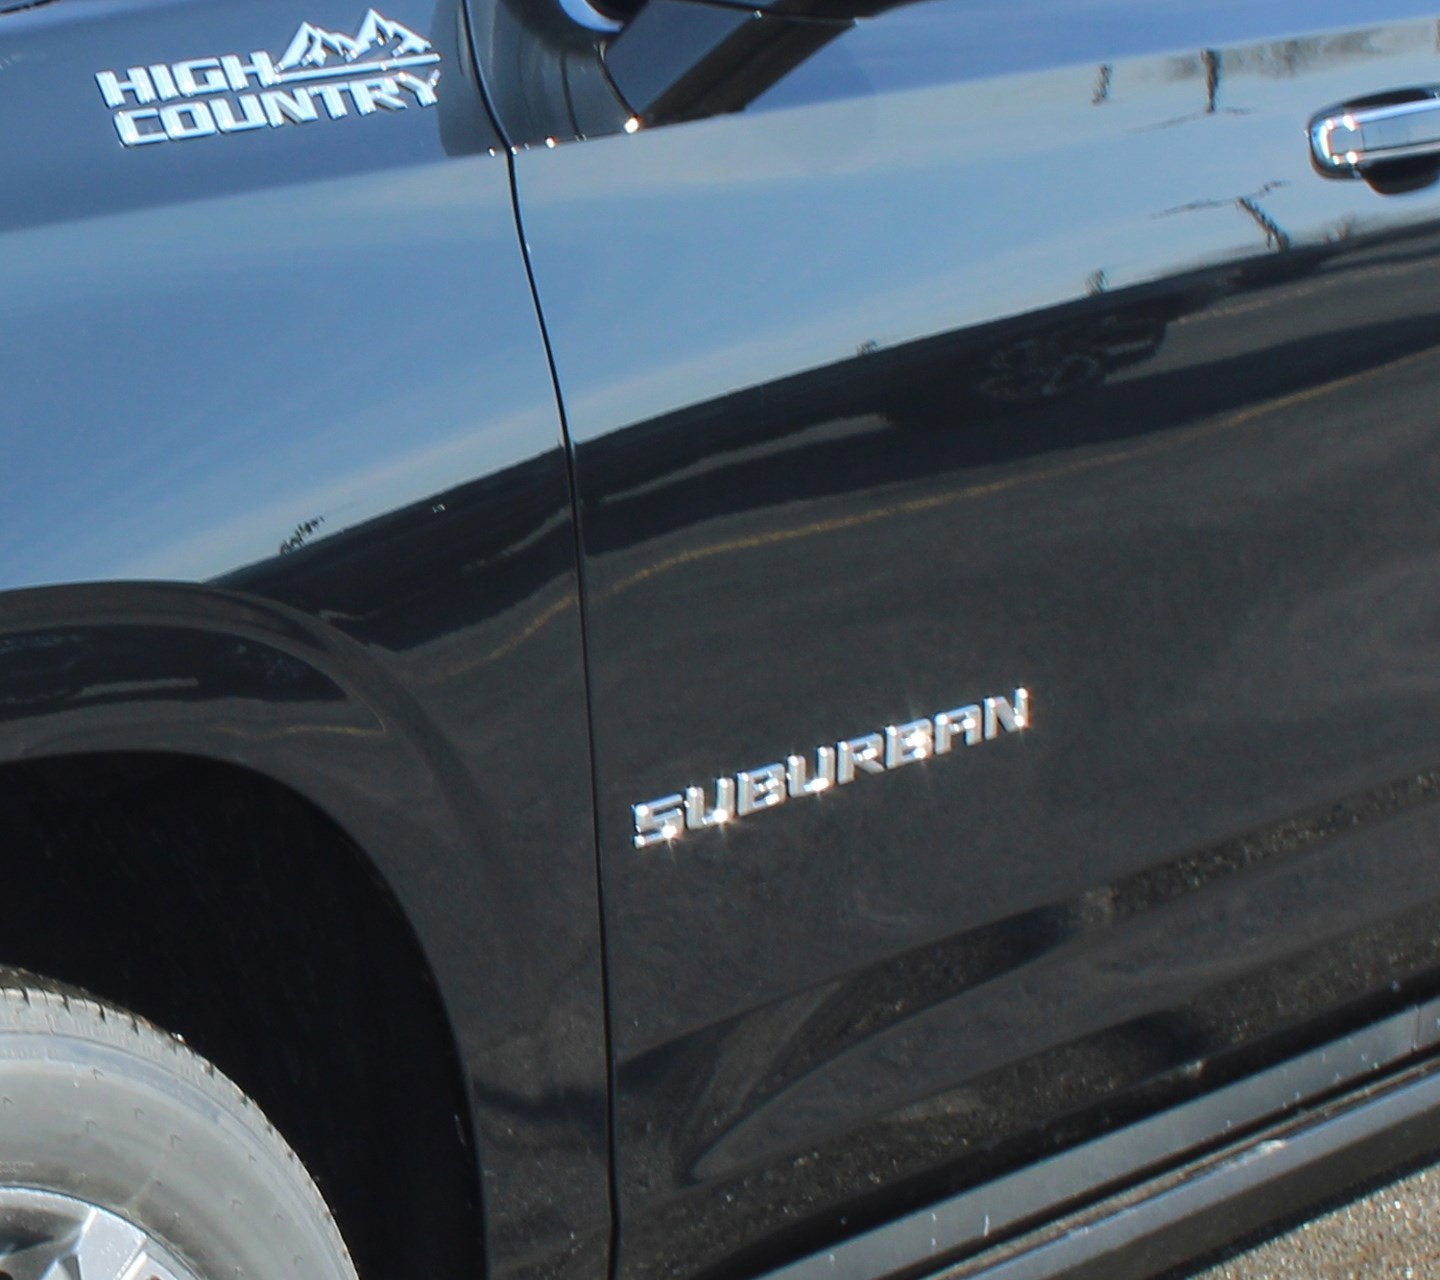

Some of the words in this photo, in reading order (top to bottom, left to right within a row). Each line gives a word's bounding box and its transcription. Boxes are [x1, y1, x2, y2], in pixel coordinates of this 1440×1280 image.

[95, 50, 278, 109] HIGH
[113, 69, 441, 148] COUNTRY
[633, 687, 1030, 848] SUBURBAN
